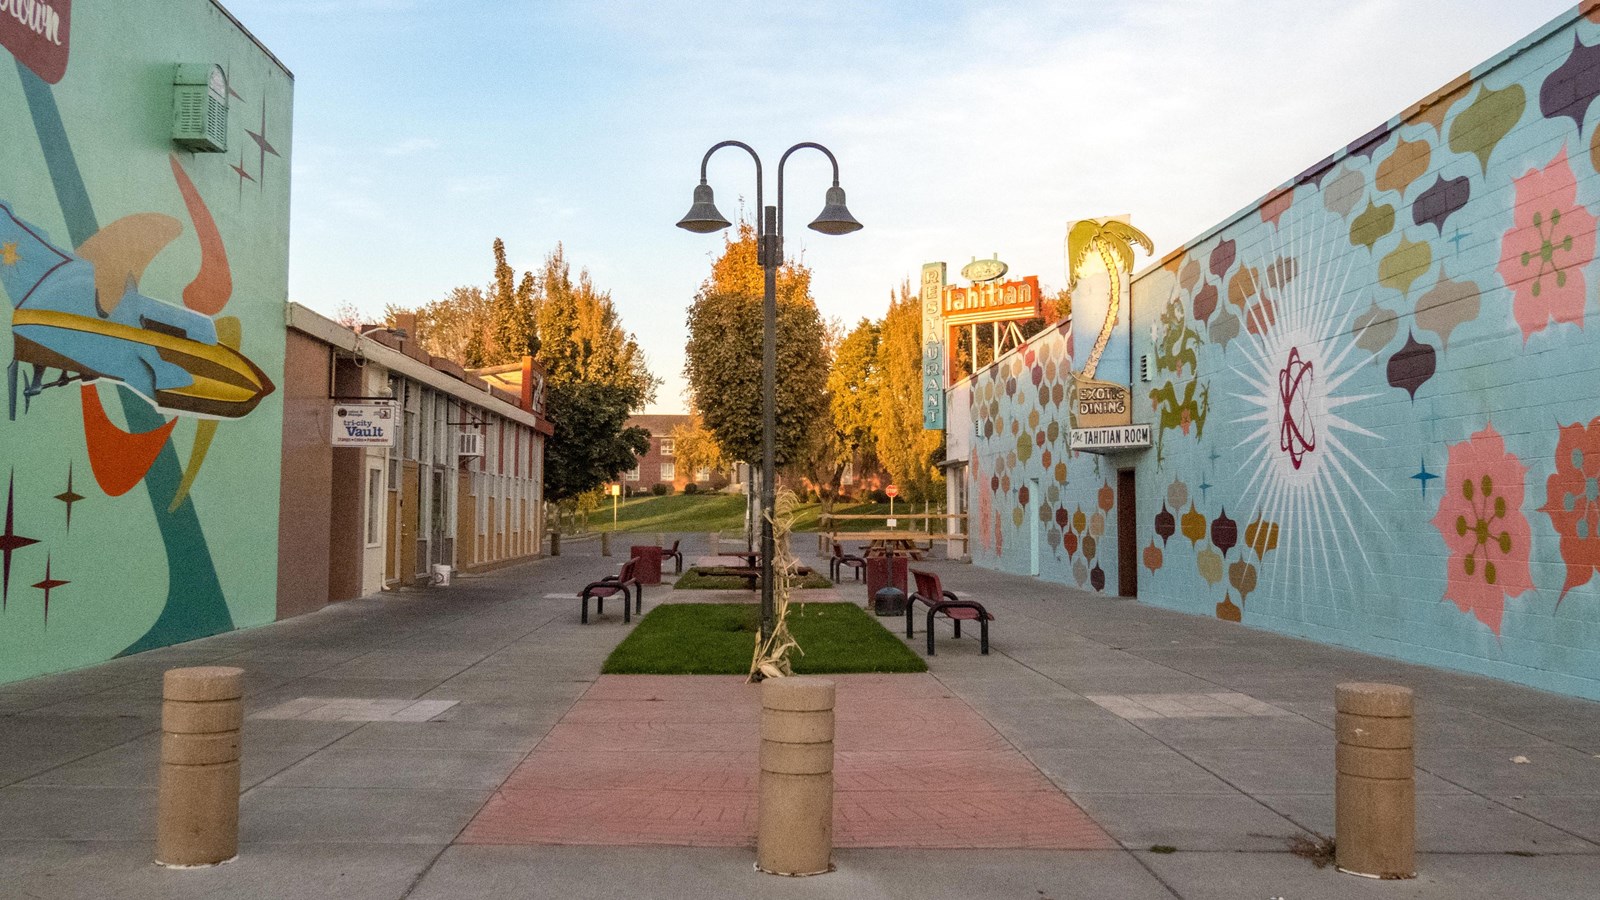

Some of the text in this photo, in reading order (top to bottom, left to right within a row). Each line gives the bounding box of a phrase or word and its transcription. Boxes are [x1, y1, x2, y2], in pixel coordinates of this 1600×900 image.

[943, 279, 1032, 311] Tahitian
[925, 270, 940, 423] RESTAURANT
[1080, 388, 1124, 400] EXOTIC
[1080, 402, 1125, 414] DINING
[346, 427, 383, 436] Vault
[1084, 429, 1121, 445] TAHITIAN
[1124, 428, 1148, 441] ROOM
